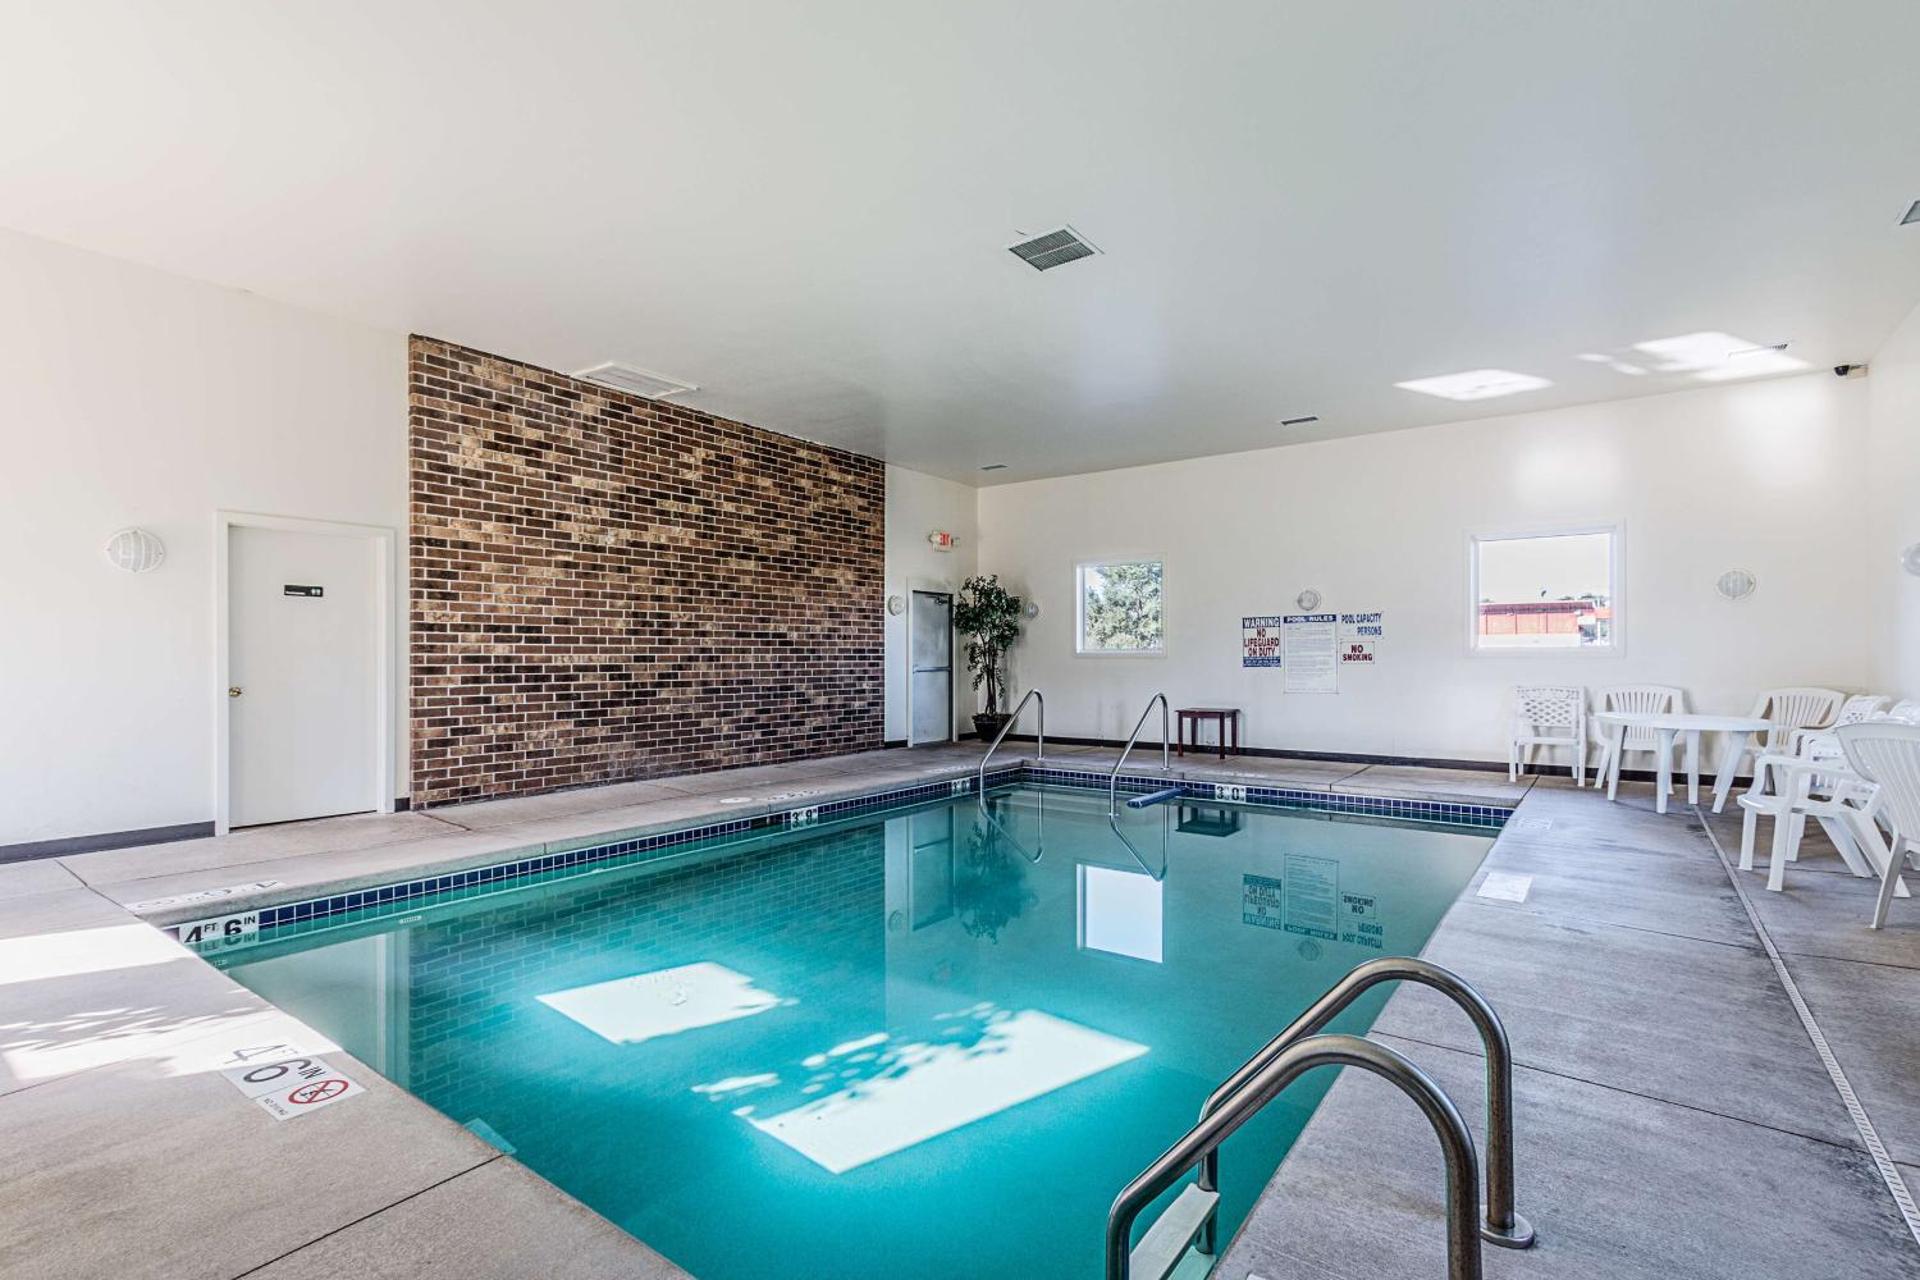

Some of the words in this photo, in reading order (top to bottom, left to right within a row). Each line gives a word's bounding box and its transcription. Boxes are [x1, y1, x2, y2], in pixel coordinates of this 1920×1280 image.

[1243, 616, 1280, 628] WARNING
[1308, 614, 1334, 622] RULES
[1341, 613, 1355, 624] POOL
[1356, 612, 1382, 623] CAPACITY
[1256, 628, 1267, 638] NO
[1357, 626, 1382, 636] PERSONS
[1243, 637, 1280, 648] LIFEGUARD
[1247, 648, 1258, 657] ON
[1259, 647, 1276, 657] DUTY
[1351, 644, 1364, 653] NO
[1342, 653, 1373, 662] SMOKING
[204, 922, 217, 932] FT
[224, 918, 242, 936] 6
[243, 915, 256, 925] IN
